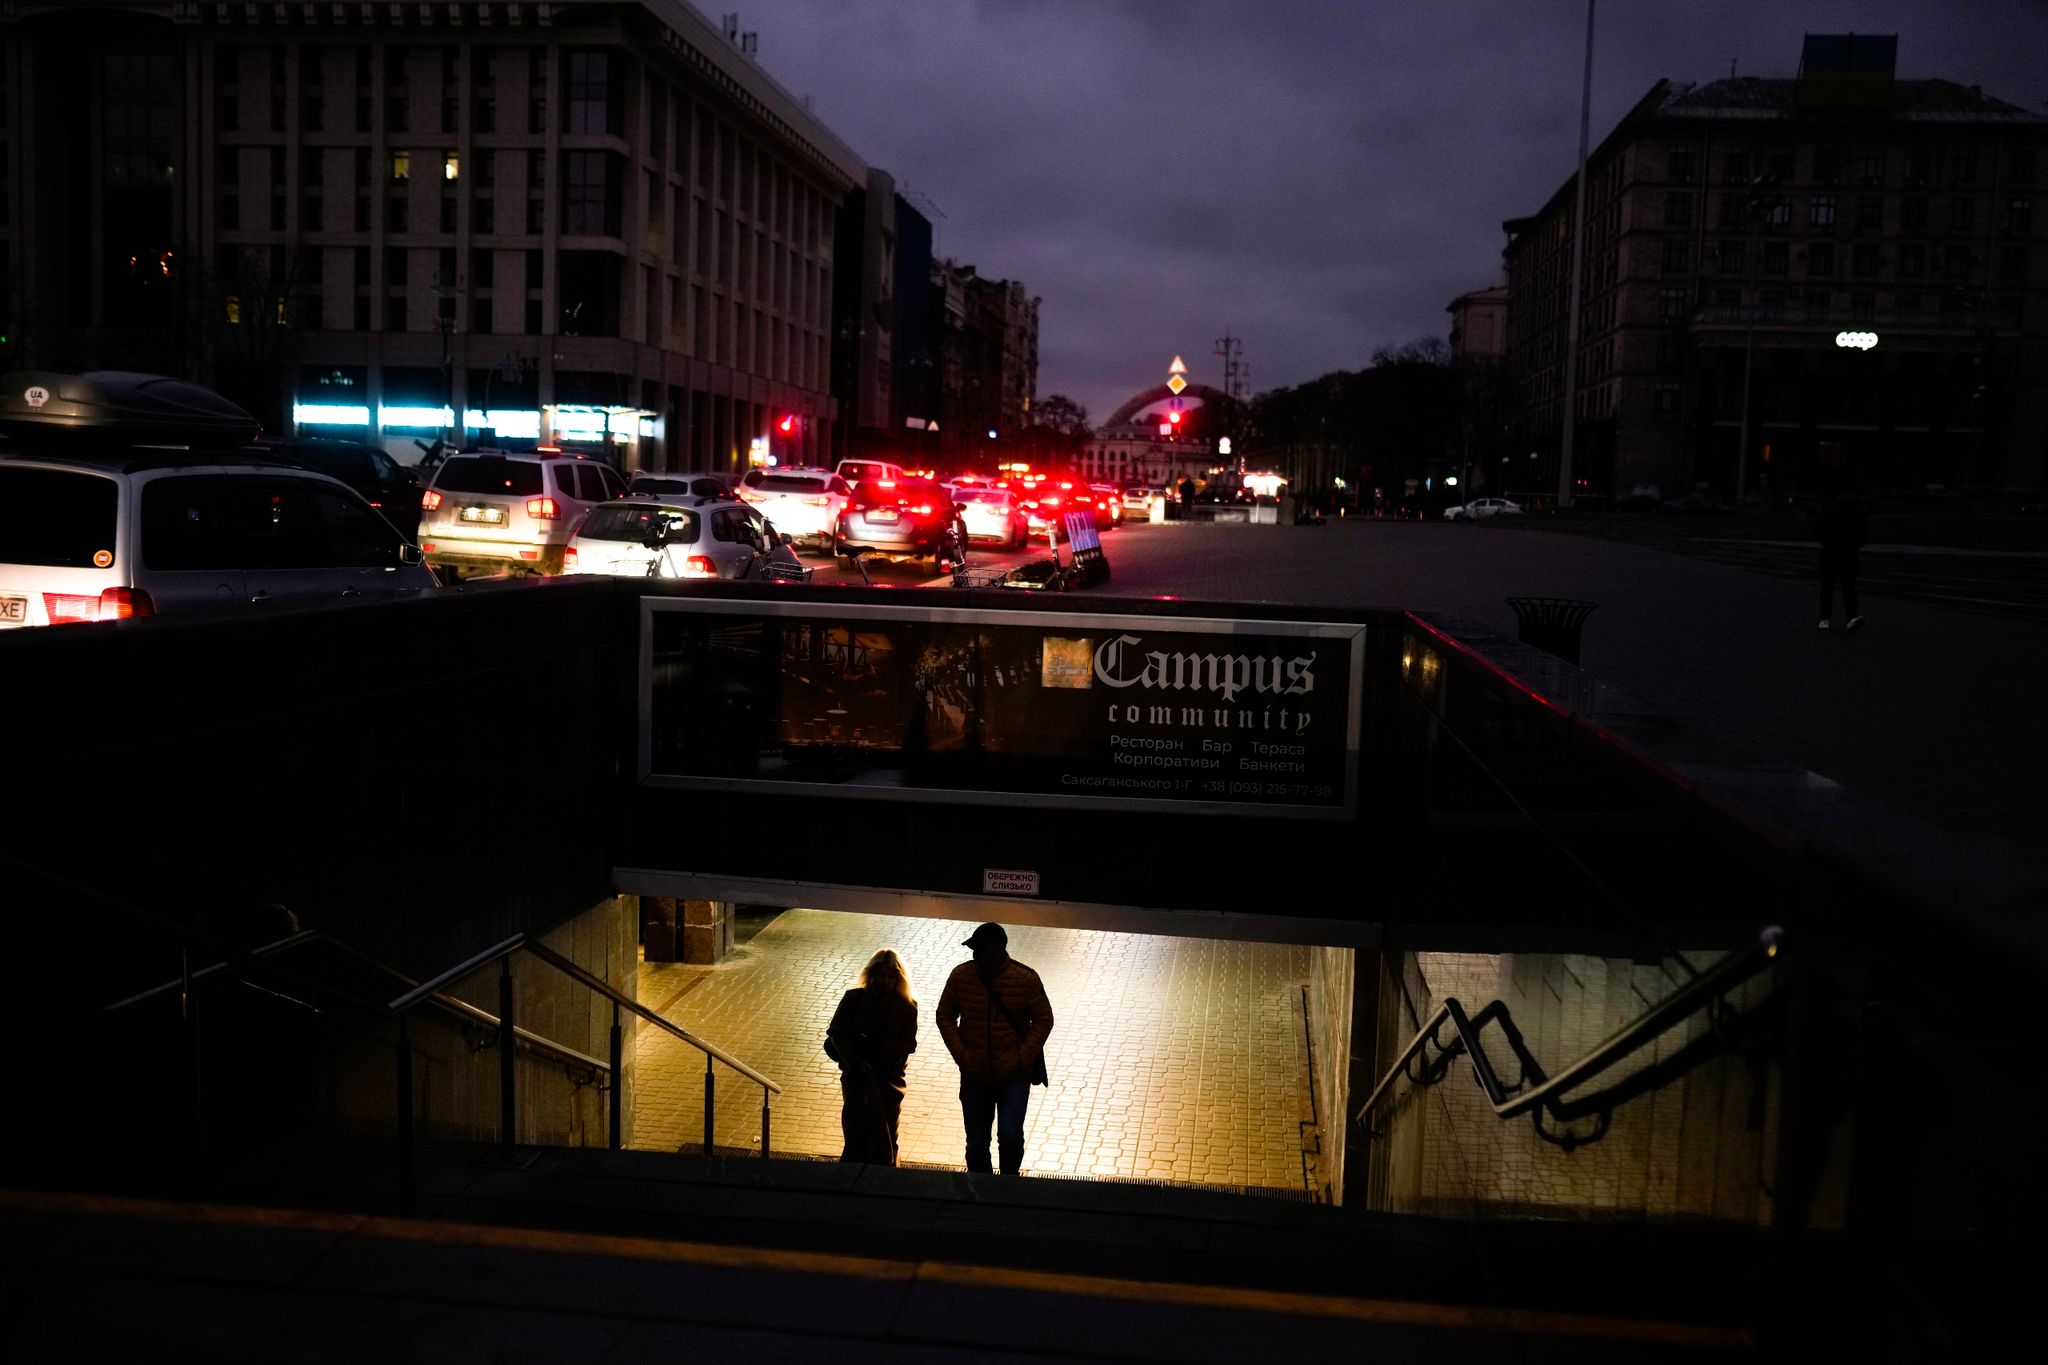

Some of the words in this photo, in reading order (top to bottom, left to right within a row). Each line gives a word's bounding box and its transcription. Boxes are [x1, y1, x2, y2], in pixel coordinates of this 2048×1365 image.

[31, 391, 43, 400] UA
[1094, 634, 1317, 703] Campus
[1108, 703, 1311, 736] community
[1110, 735, 1183, 750] Ресторан
[1202, 740, 1232, 752] Бар
[1251, 742, 1305, 755] Тераса
[1114, 752, 1219, 769] Корпоративи
[1239, 758, 1305, 772] Банкети
[1061, 774, 1172, 789] Саксаганського
[1202, 781, 1225, 791] +38
[1229, 781, 1262, 795] (093)
[987, 872, 1036, 881] ОБЕРЕЖНО!
[991, 882, 1032, 891] СЛИЗЬКО
